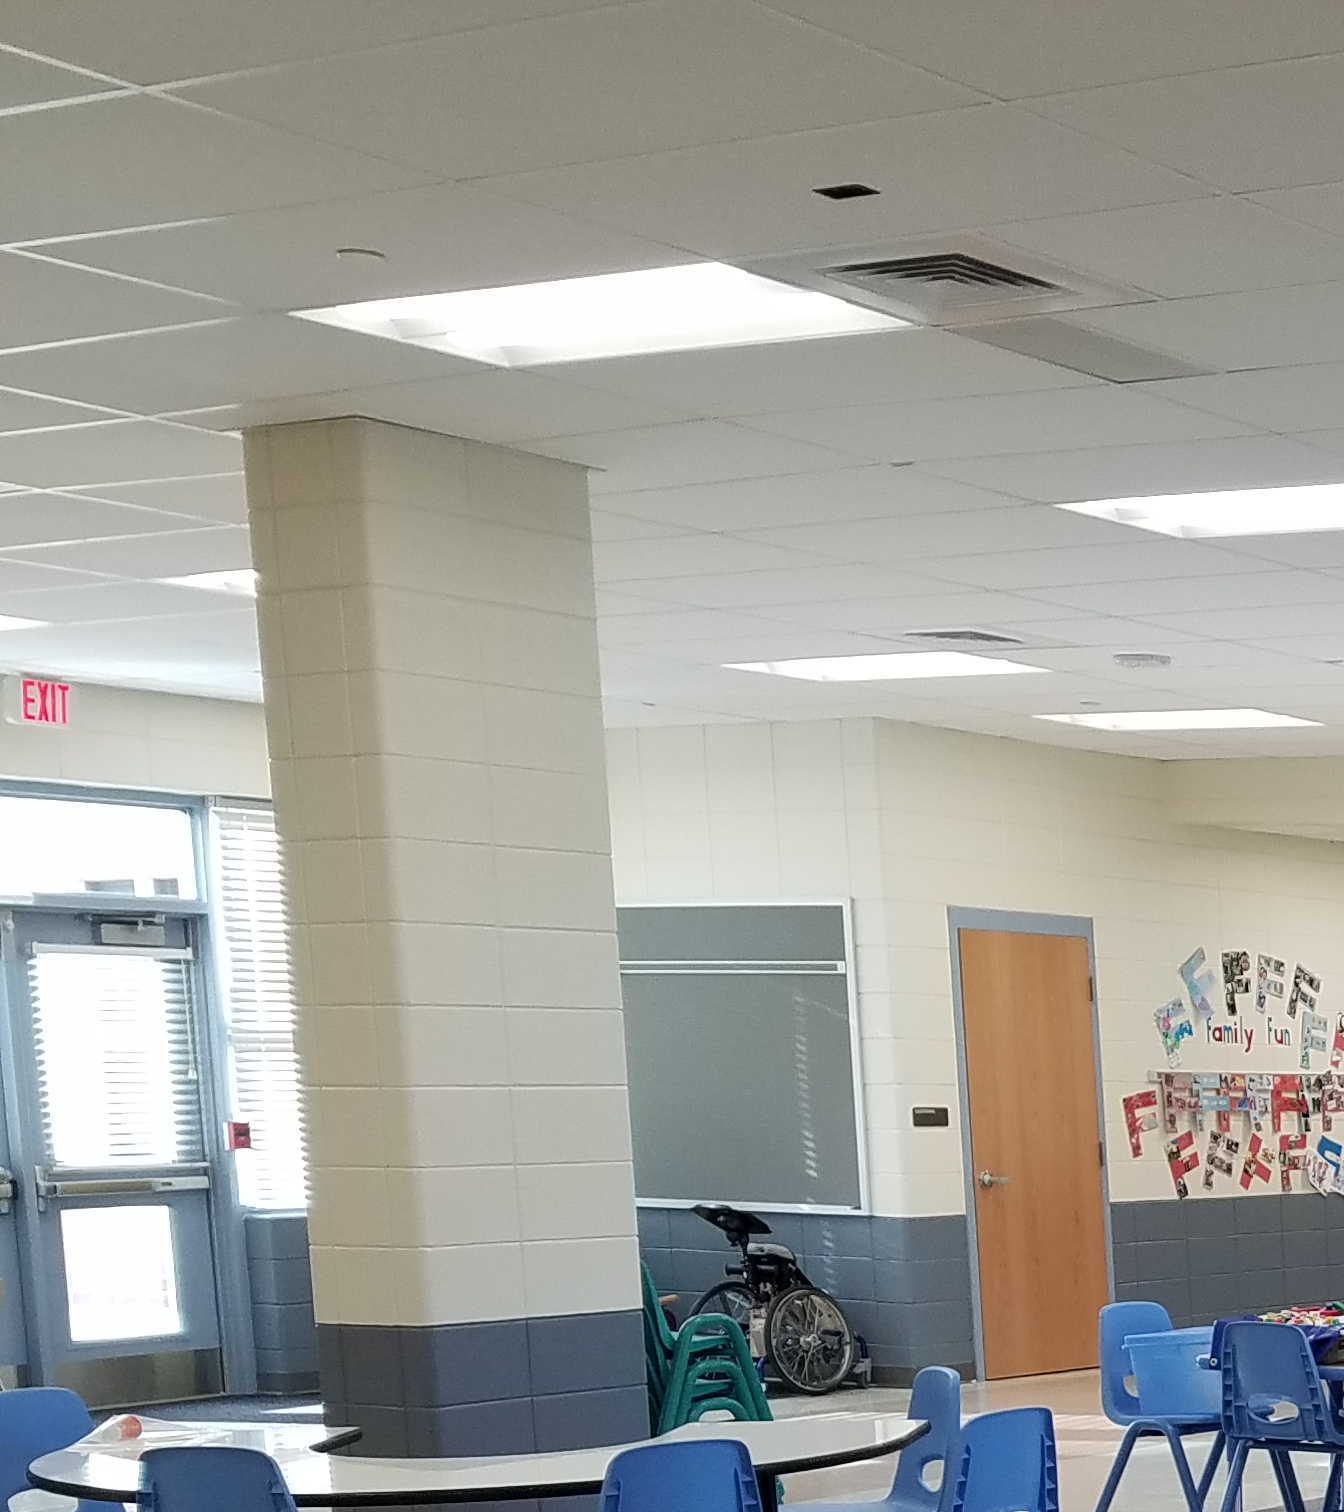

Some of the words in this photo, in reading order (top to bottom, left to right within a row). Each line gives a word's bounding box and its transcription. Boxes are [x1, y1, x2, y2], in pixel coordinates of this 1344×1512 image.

[21, 679, 69, 724] EXIT
[1206, 1015, 1254, 1053] family
[1267, 1016, 1291, 1046] fun
